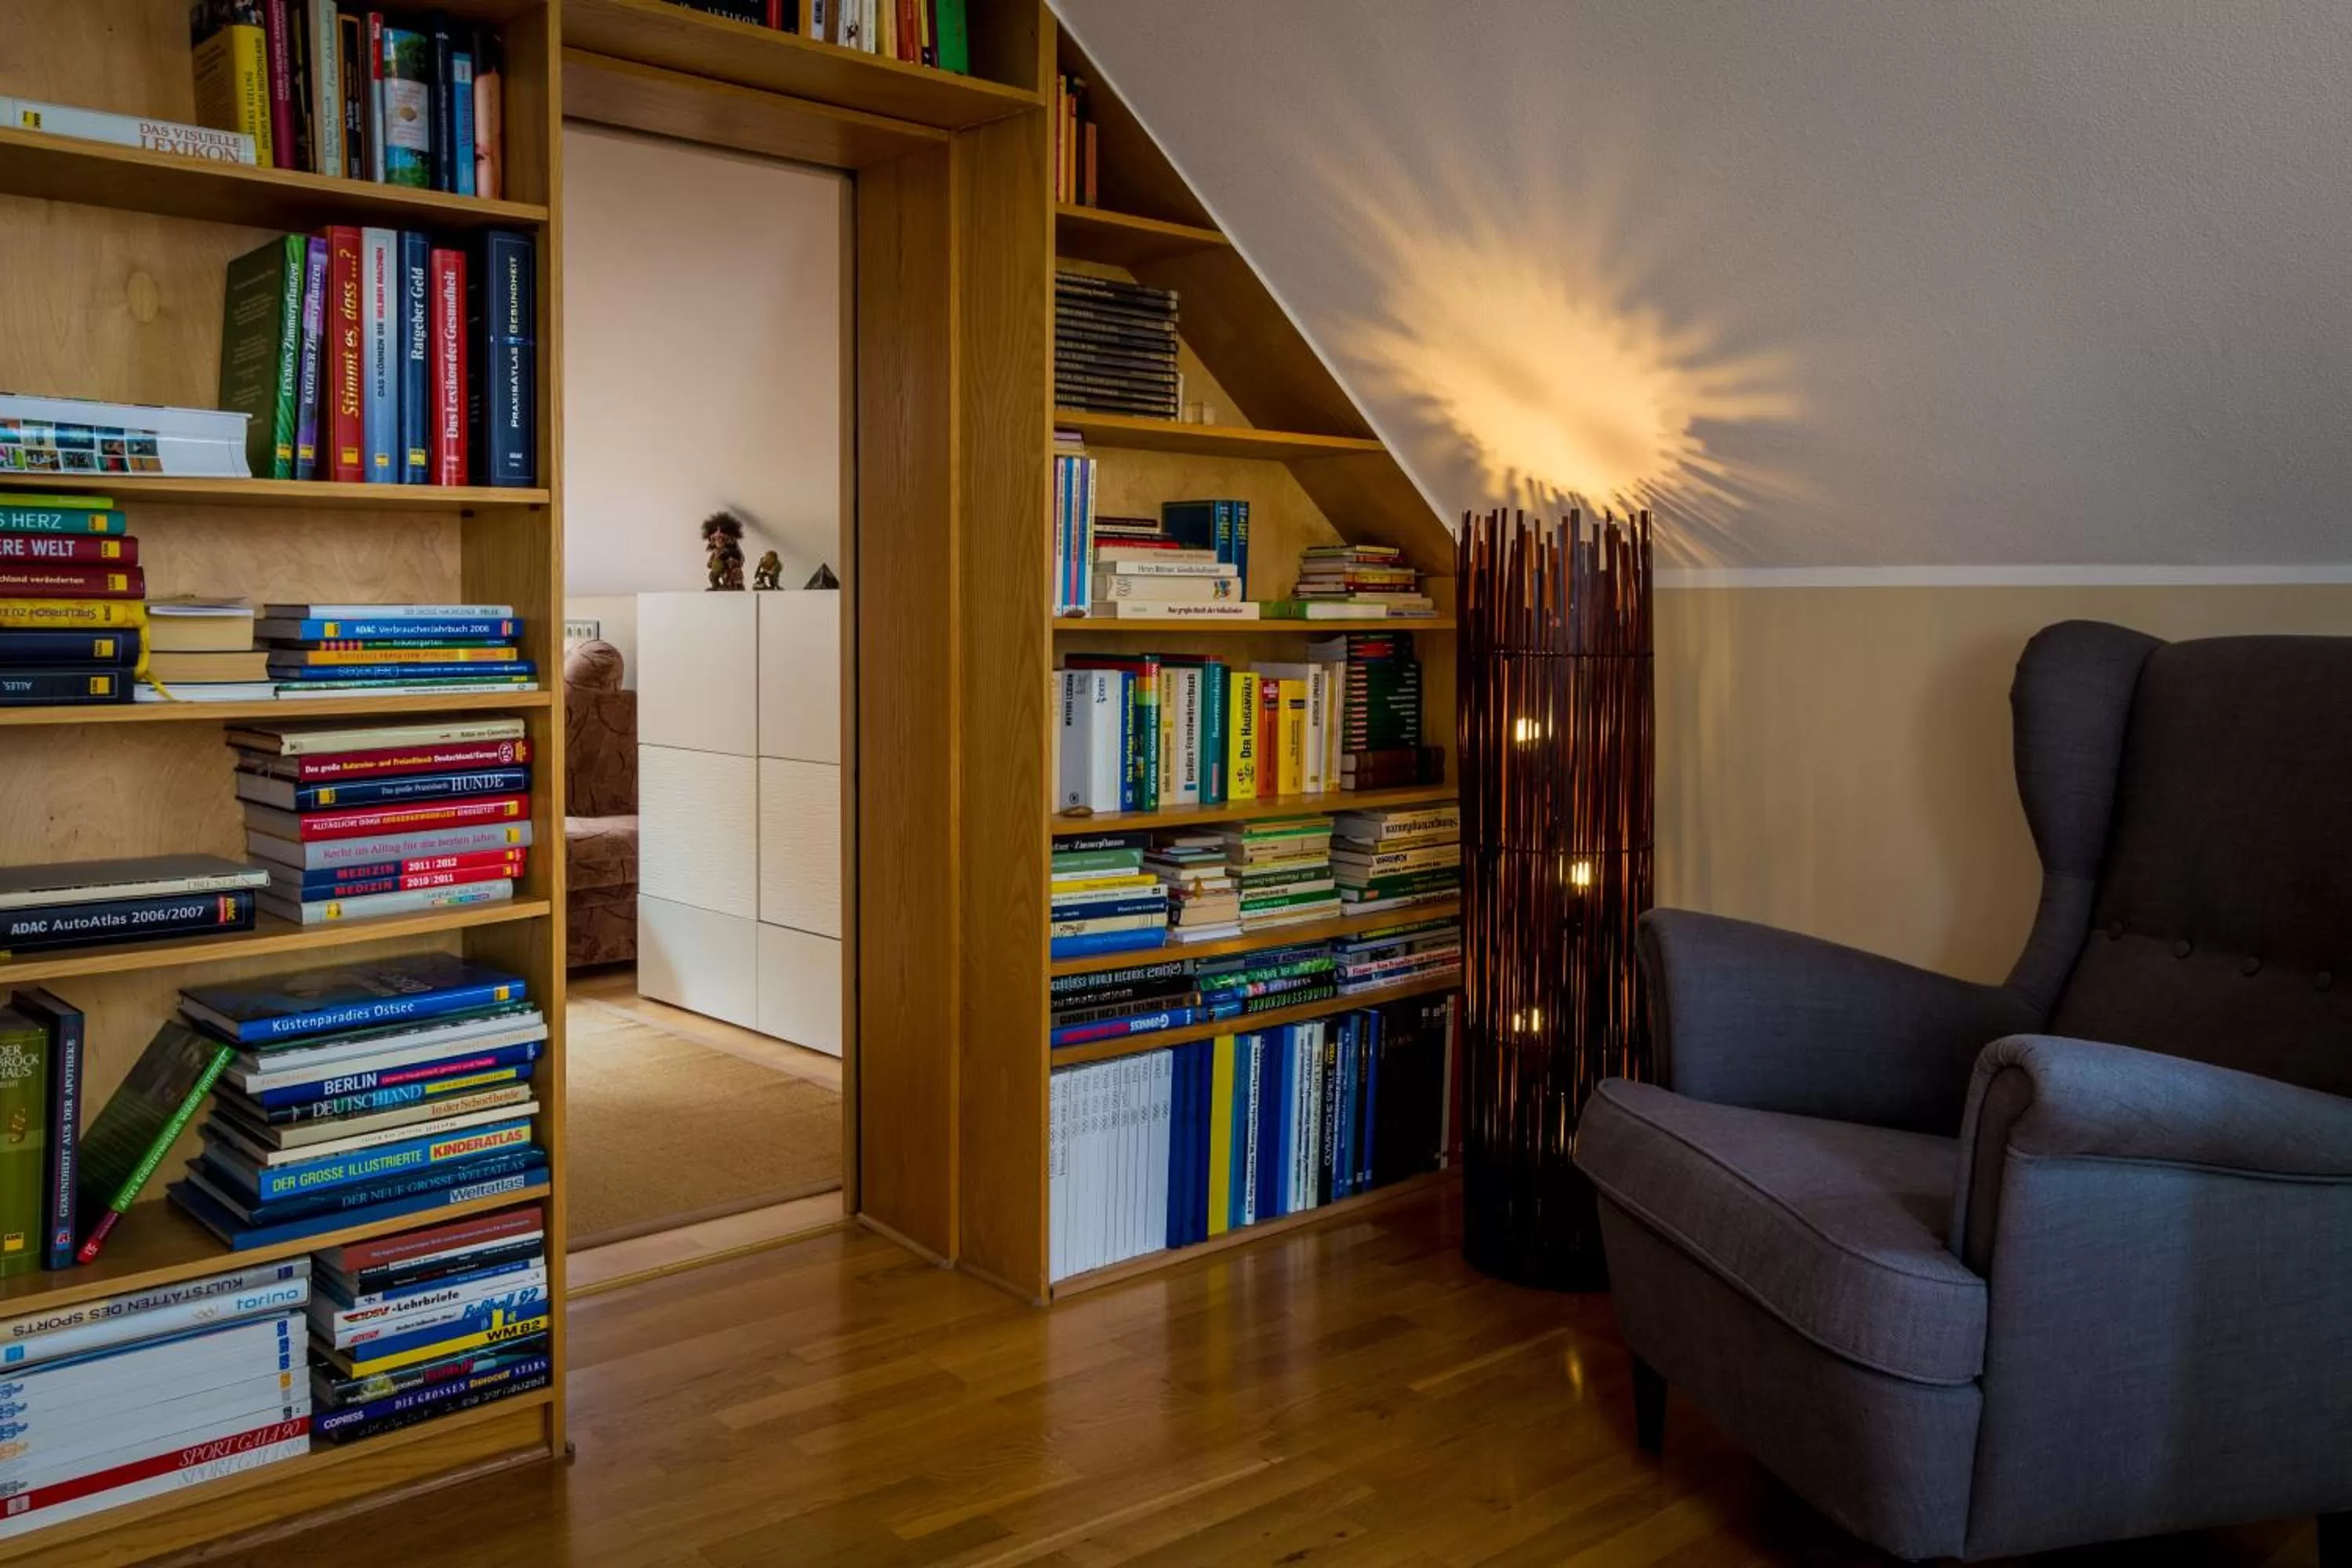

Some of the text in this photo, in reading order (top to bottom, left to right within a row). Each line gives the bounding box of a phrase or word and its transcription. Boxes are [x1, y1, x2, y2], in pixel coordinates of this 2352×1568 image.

[140, 122, 240, 148] DAS VISUELLE
[140, 135, 239, 164] LEXIKON
[340, 281, 357, 321] dass
[409, 266, 427, 360] Ratgeber Geld
[443, 270, 457, 339] Gesundheit
[341, 350, 358, 417] Stimmt
[445, 414, 459, 438] Das
[12, 514, 62, 529] HERZ
[0, 539, 76, 557] RE WELT
[1240, 739, 1253, 758] DER
[452, 775, 504, 791] HUNDE
[334, 879, 393, 896] MEDIZIN
[11, 905, 205, 935] ADAC AutoAtlas 2006/2007
[272, 1000, 415, 1033] Küstenparadies Ostsee
[324, 1073, 377, 1095] BERLIN
[313, 1084, 423, 1118] DEUTSCHLAND
[274, 1177, 296, 1192] DER
[300, 1166, 344, 1187] GROSSE
[349, 1149, 423, 1177] ILLUSTRIERTE
[434, 1129, 523, 1160] KINDERATLAS
[451, 1177, 524, 1203] Weltatlas
[89, 1303, 122, 1319] DES
[237, 1289, 299, 1311] torino
[12, 1310, 85, 1337] SPORTS
[486, 1324, 518, 1341] WM
[179, 1441, 236, 1467] SPORT
